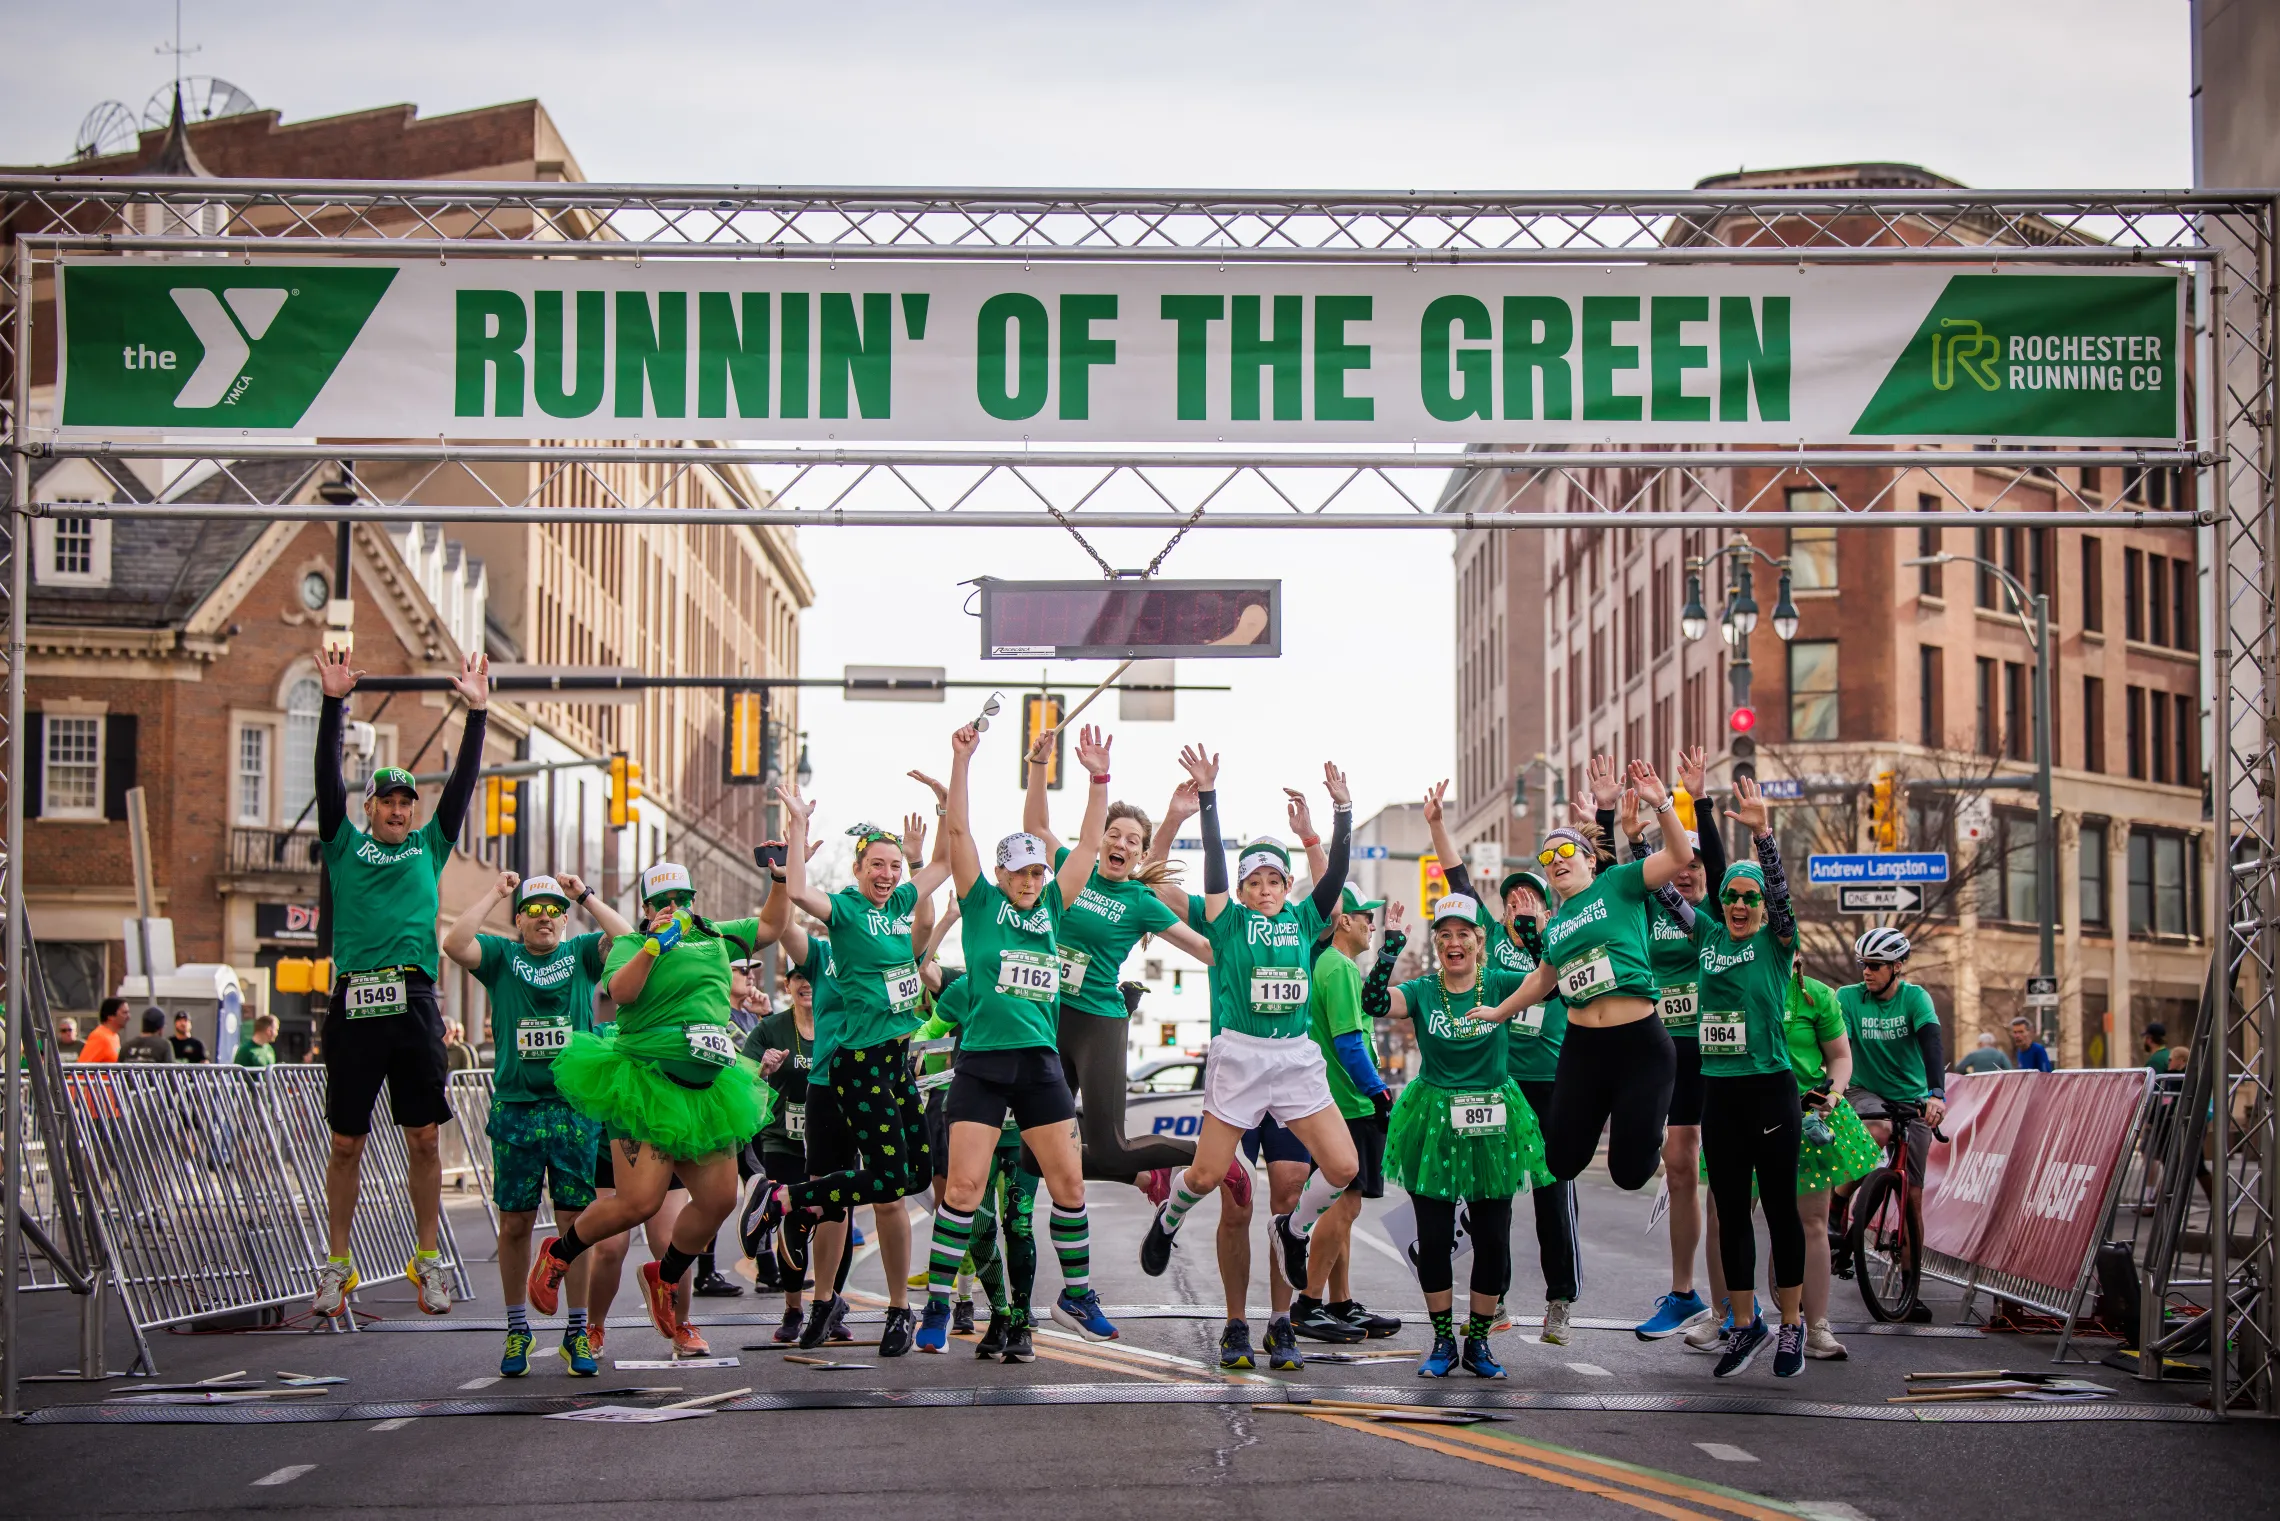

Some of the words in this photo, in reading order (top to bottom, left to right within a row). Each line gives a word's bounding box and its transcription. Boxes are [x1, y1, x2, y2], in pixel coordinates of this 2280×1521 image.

[123, 344, 177, 370] the
[453, 289, 930, 420] RUNNIN'
[976, 293, 1119, 421] OF
[1160, 294, 1376, 423] THE
[1420, 294, 1792, 423] GREEN
[2009, 335, 2162, 361] ROCHESTER
[2009, 365, 2123, 391] RUNNING
[223, 375, 254, 406] YMCA
[1813, 861, 1864, 877] Andrew
[1867, 859, 1928, 880] Langston
[1073, 896, 1109, 917] RUNNING
[1079, 886, 1127, 915] ROCHESTER
[1848, 894, 1869, 904] ONE
[1874, 895, 1896, 903] WAY
[1559, 914, 1593, 941] RUNNING
[533, 966, 572, 987] RUNNING
[534, 955, 576, 977] ROCHESTER
[898, 977, 918, 998] 923
[1011, 966, 1052, 989] 1162
[1569, 965, 1596, 992] 687
[354, 986, 397, 1005] 1549
[1261, 983, 1301, 1001] 1130
[1664, 997, 1692, 1015] 630
[525, 1030, 565, 1047] 1816
[701, 1035, 728, 1054] 362
[1703, 1026, 1736, 1042] 1964
[1465, 1107, 1493, 1124] 897
[2036, 1161, 2097, 1222] USATF
